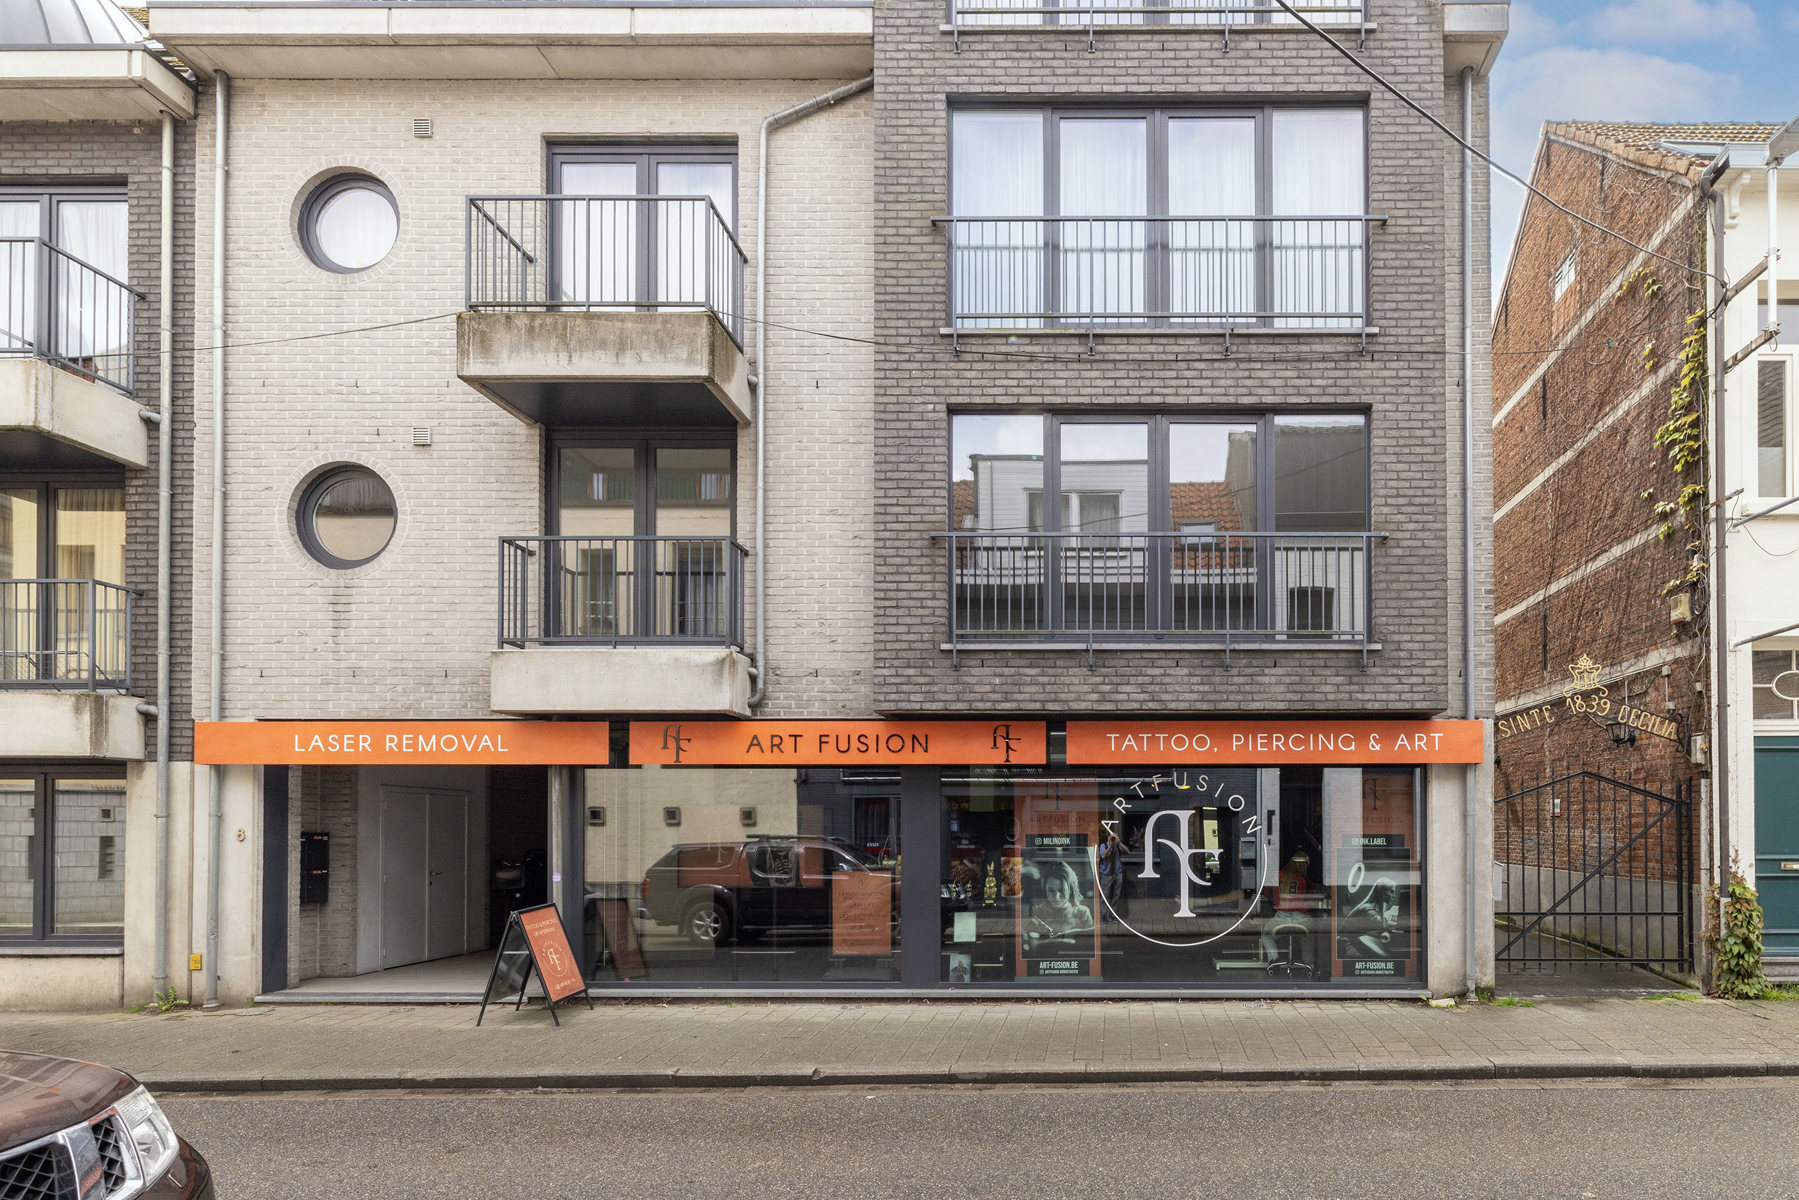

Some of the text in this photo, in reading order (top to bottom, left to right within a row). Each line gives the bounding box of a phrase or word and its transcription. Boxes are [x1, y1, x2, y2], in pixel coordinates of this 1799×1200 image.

[1566, 694, 1611, 716] 1839
[1498, 705, 1677, 738] SINTE CECILIA
[294, 734, 508, 752] LASER REMOVAL
[746, 733, 929, 754] ART FUSION
[1106, 733, 1444, 753] TATTOO, PIERCING & ART
[1101, 771, 1262, 835] ARTFUSION
[1365, 815, 1403, 824] FUSION
[236, 827, 246, 842] 8
[1039, 961, 1079, 969] ART-FUSION.BE
[1355, 961, 1394, 970] ART-FUSION.BE
